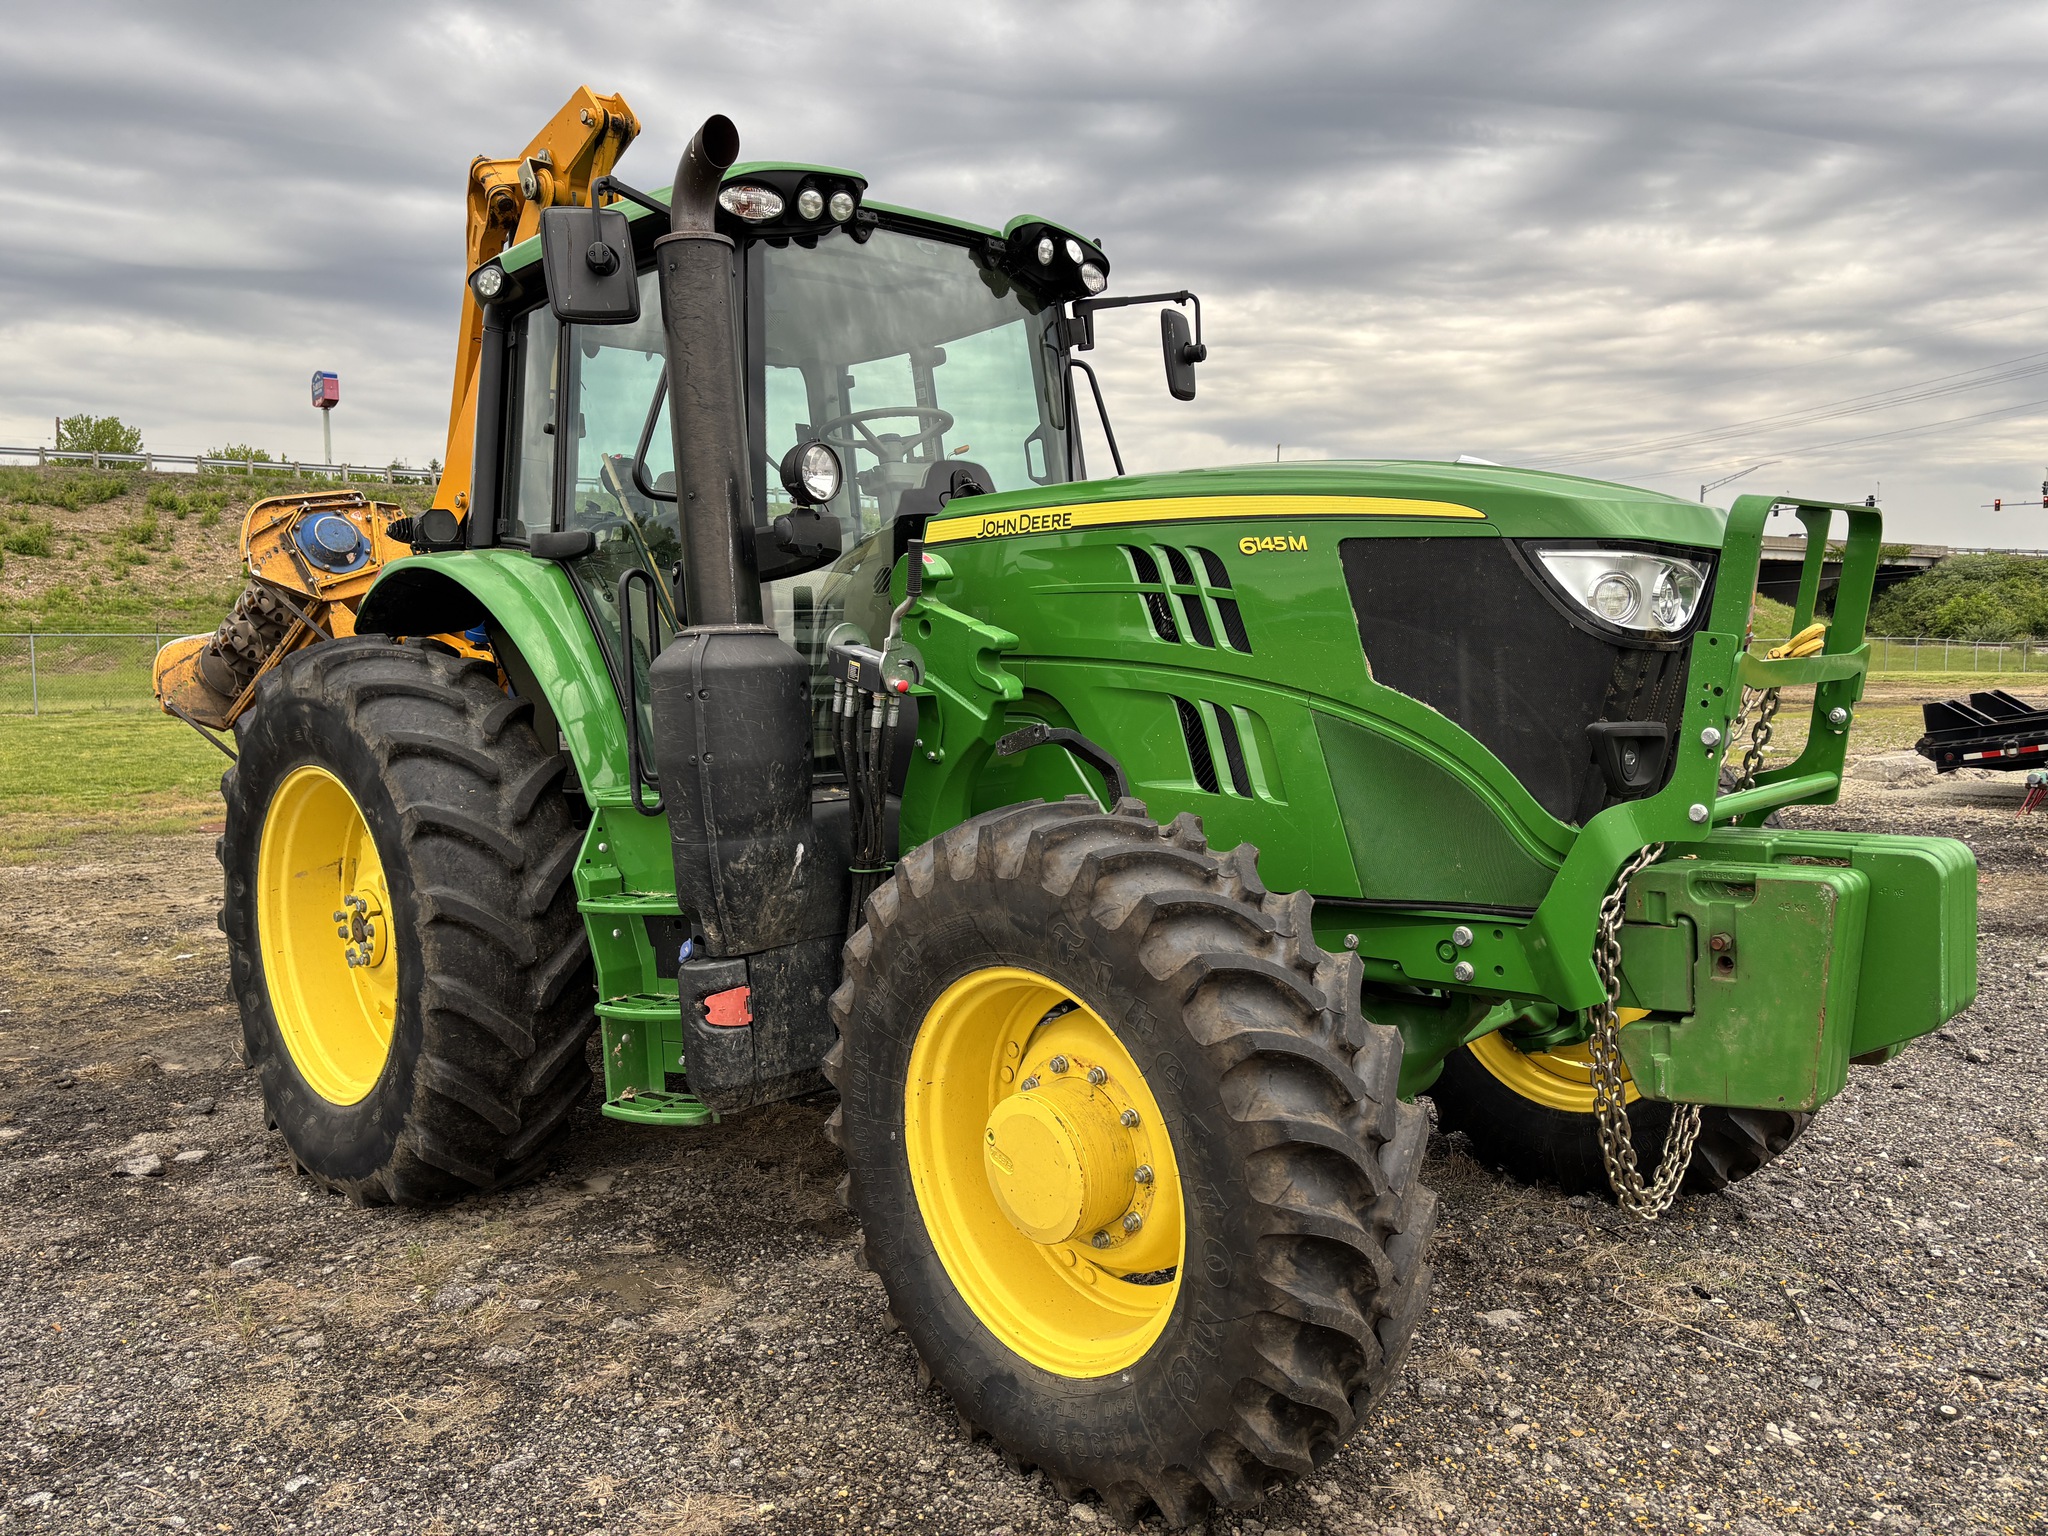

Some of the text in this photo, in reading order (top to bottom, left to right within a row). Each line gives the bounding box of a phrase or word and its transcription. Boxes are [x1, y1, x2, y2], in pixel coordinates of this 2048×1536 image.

[977, 512, 1072, 536] JOHN DEERE
[1777, 902, 1808, 913] 45 KG
[1893, 887, 1905, 897] KG
[861, 974, 891, 1033] FWD
[850, 1045, 881, 1208] TRACTION
[877, 1228, 911, 1290] ALL
[914, 1304, 988, 1410] RADIAL
